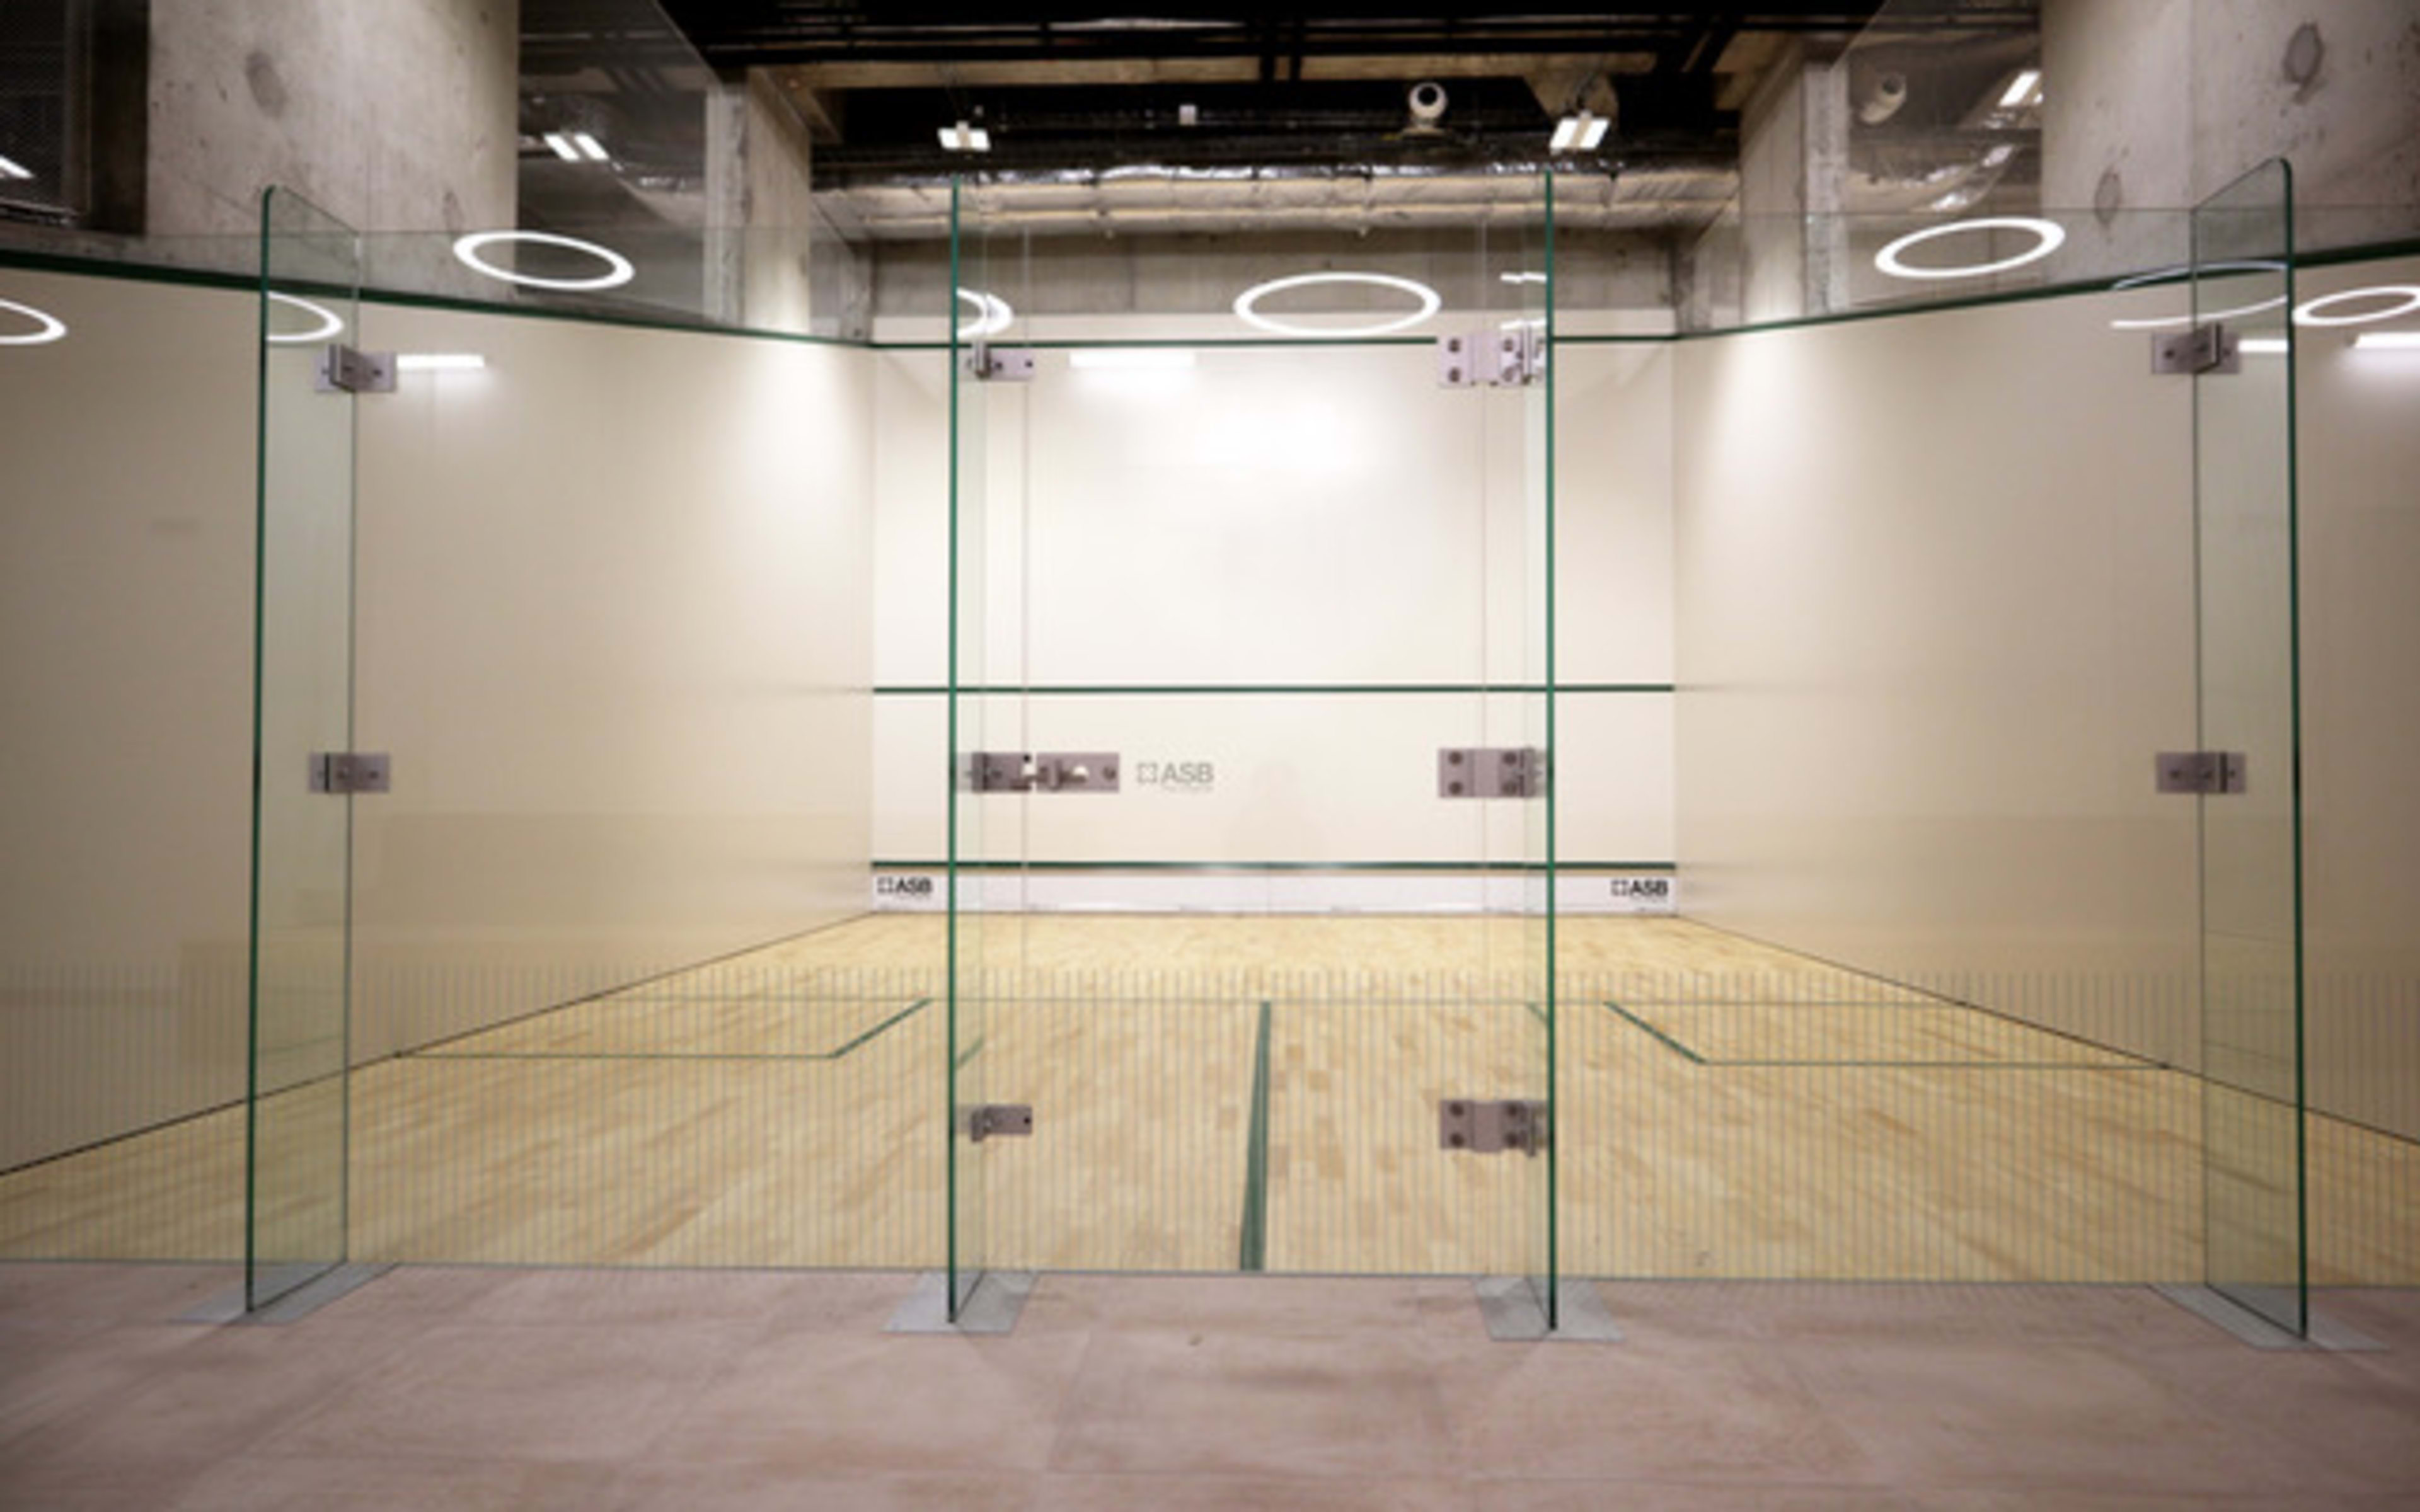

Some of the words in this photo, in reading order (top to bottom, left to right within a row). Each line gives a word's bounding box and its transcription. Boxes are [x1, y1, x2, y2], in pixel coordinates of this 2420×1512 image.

[1161, 762, 1214, 784] ASB
[895, 877, 933, 895] ASB
[1629, 879, 1669, 896] ASB
